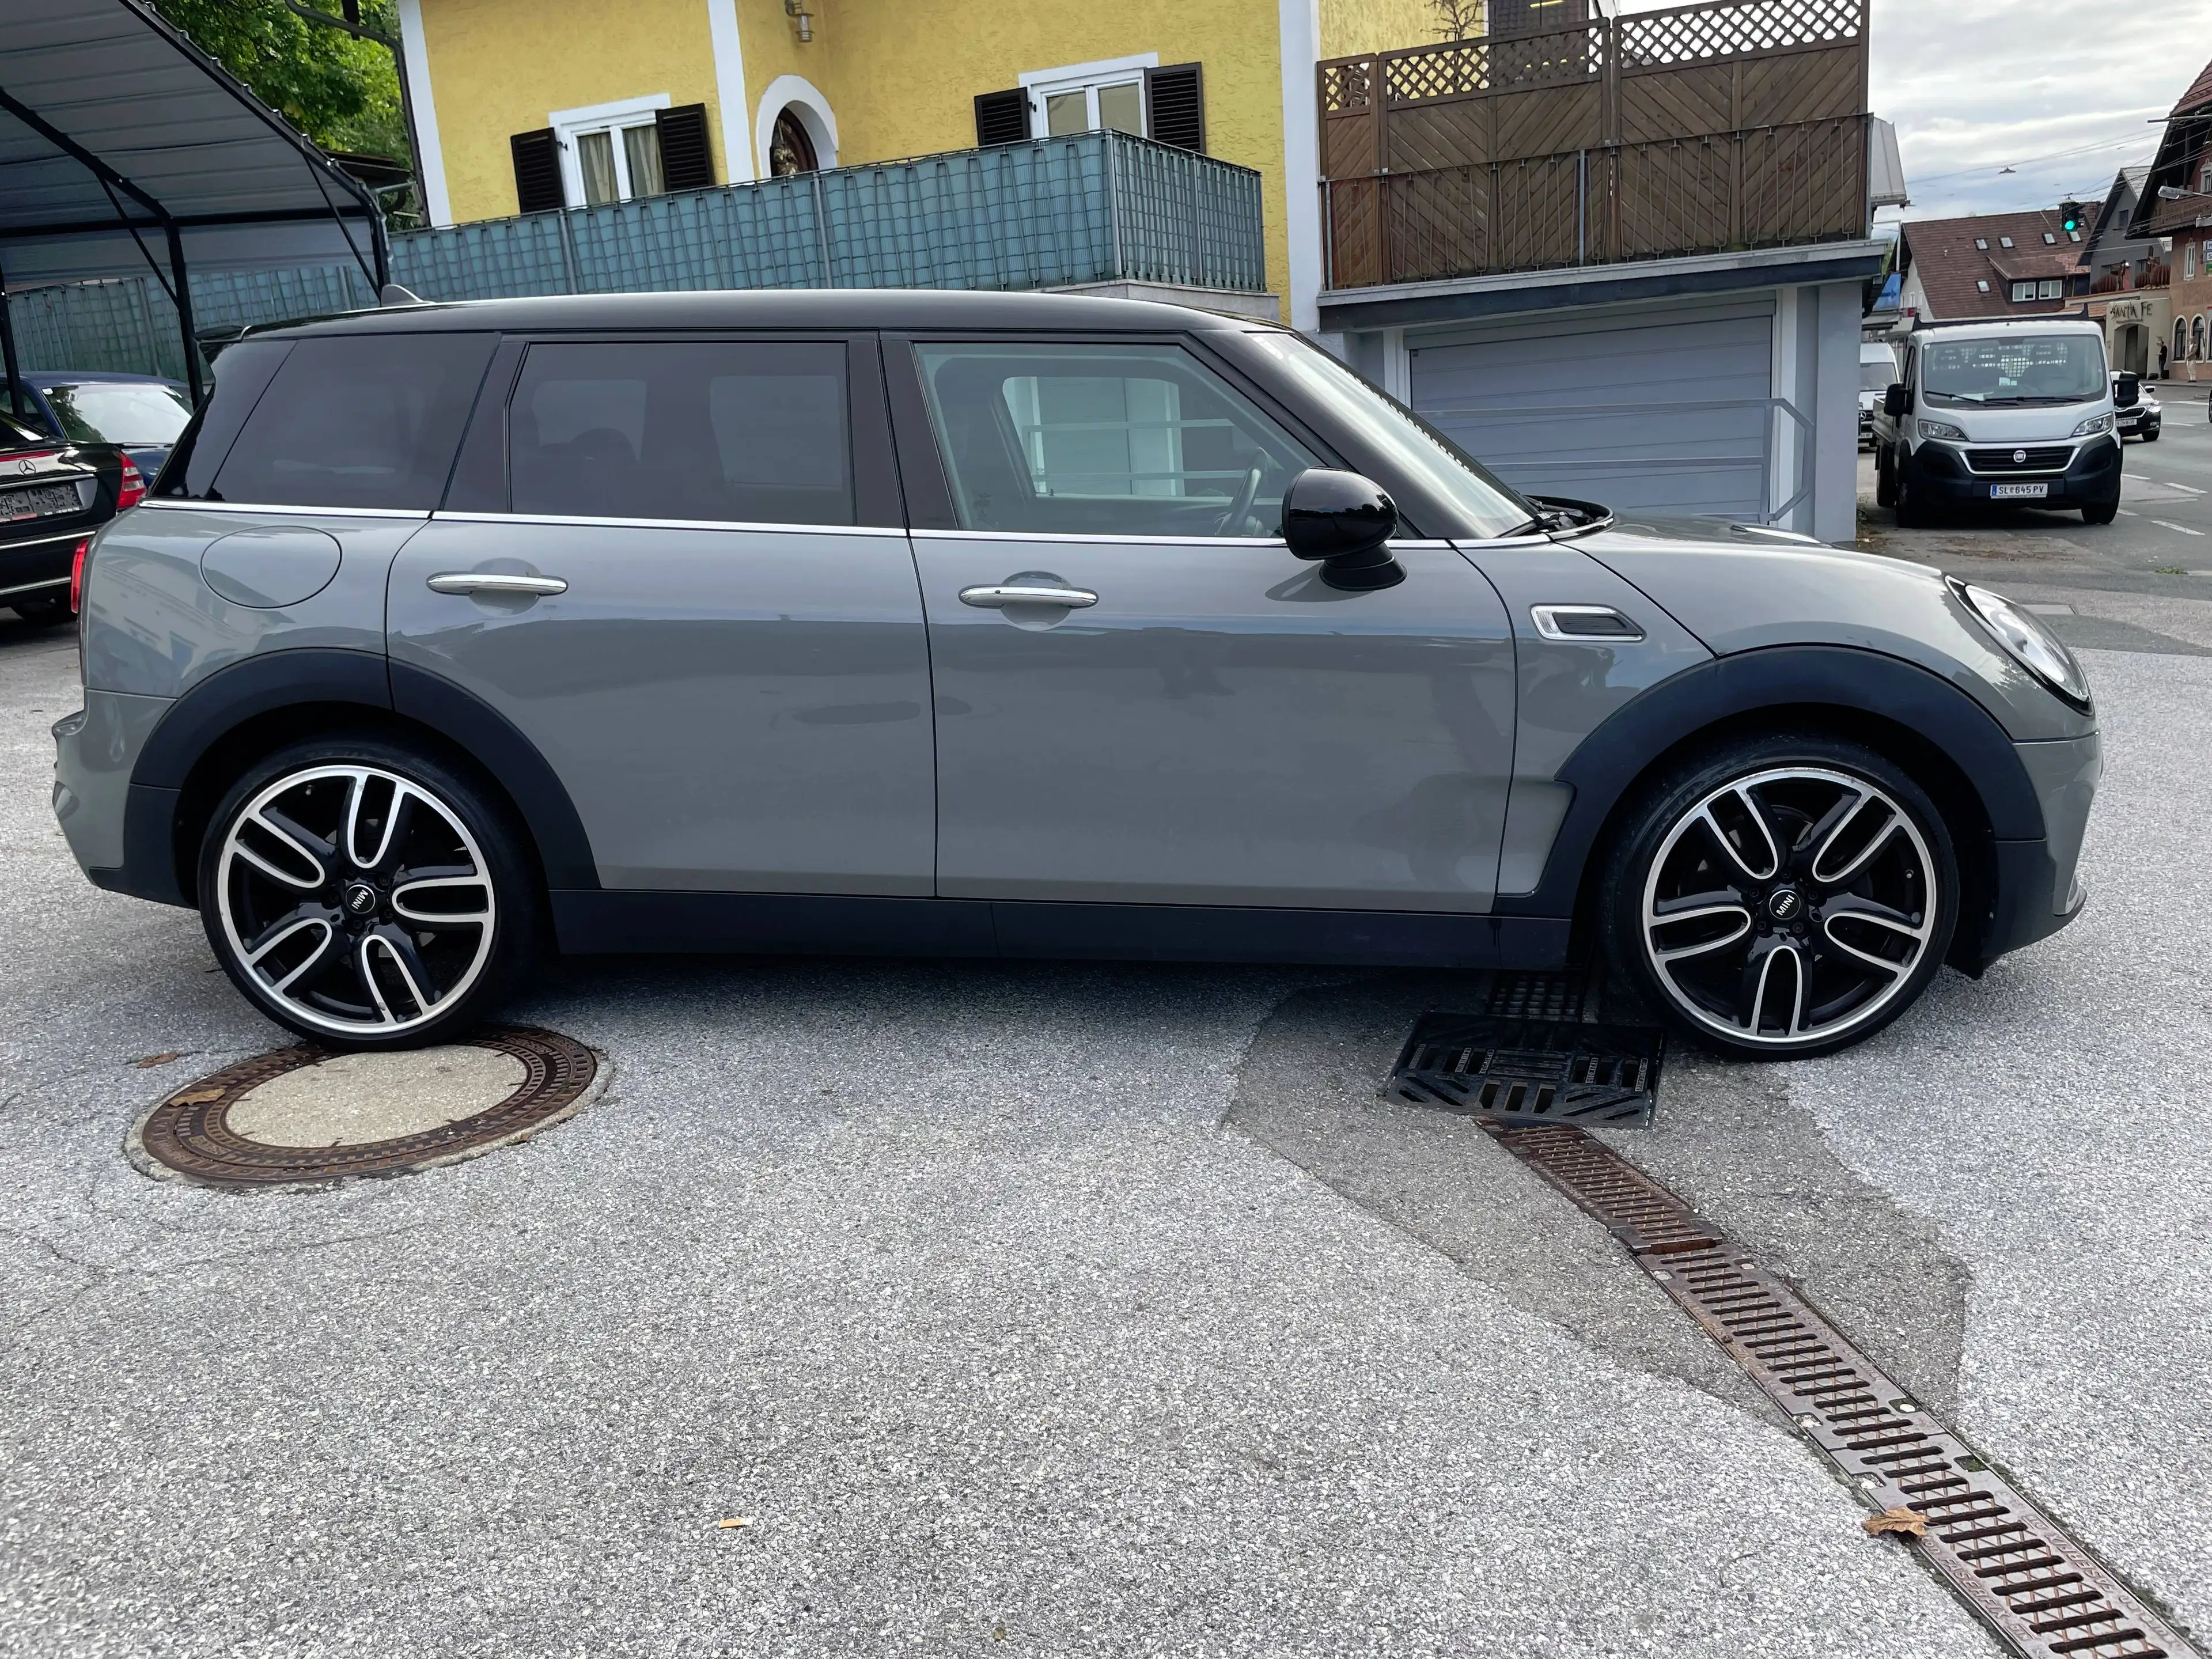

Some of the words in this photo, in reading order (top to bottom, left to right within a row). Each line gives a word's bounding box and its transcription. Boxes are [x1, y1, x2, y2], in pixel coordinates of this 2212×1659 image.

[2141, 301, 2153, 316] FE
[1999, 486, 2008, 494] SL
[2015, 486, 2031, 494] 645
[2033, 485, 2044, 494] PV
[351, 889, 369, 910] MINI
[1776, 894, 1795, 916] MINI
[2043, 1533, 2118, 1592] FASERFIX
[1939, 1558, 2011, 1619] FASERFIX
